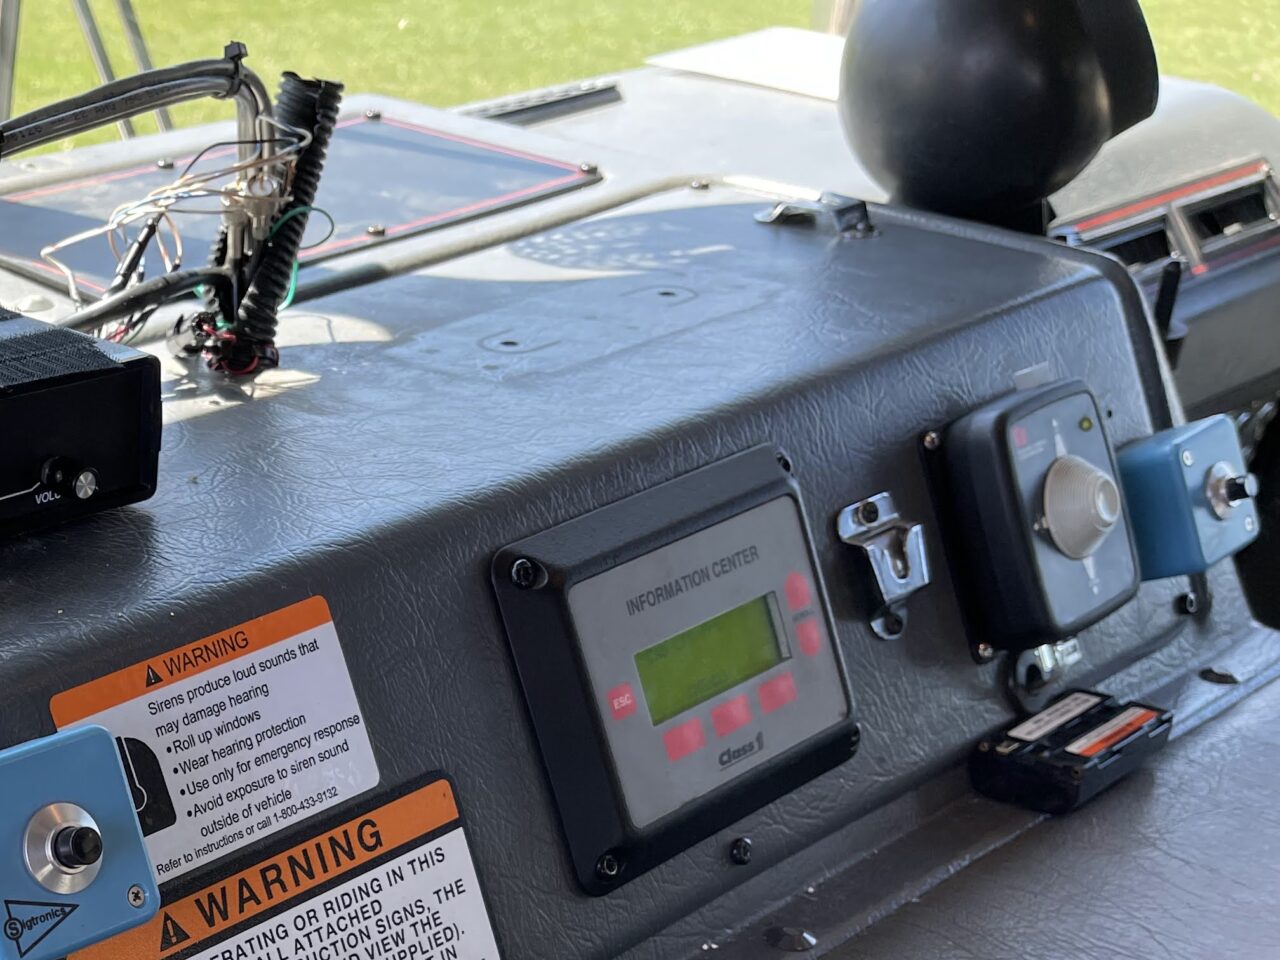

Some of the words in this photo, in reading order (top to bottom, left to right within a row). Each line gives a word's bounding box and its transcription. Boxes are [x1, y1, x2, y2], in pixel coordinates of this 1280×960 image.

[626, 568, 711, 616] INFORMATION
[712, 545, 760, 577] CENTER
[148, 694, 184, 715] Sirens
[186, 675, 231, 703] produce
[232, 662, 257, 682] loud
[258, 648, 297, 671] sounds
[298, 638, 319, 656] that
[163, 631, 248, 676] WARNING
[155, 719, 179, 737] may
[182, 701, 226, 726] damage
[227, 683, 269, 707] hearing
[613, 693, 632, 710] ESC
[172, 734, 195, 754] Roll
[197, 730, 212, 744] up
[214, 710, 261, 736] windows
[178, 754, 208, 774] Wear
[210, 737, 253, 761] hearing
[255, 715, 306, 746] protection
[186, 779, 209, 795] Use
[212, 767, 233, 785] only
[236, 760, 251, 774] for
[254, 735, 310, 766] emergency
[313, 714, 360, 741] response
[719, 737, 755, 766] Class
[753, 731, 764, 751] 1
[194, 793, 223, 817] Avoid
[226, 774, 275, 802] exposure
[276, 768, 287, 780] to
[290, 756, 316, 774] siren
[317, 738, 349, 762] sound
[156, 857, 181, 875] Refer
[183, 853, 193, 863] to
[193, 830, 244, 858] instructions
[245, 825, 254, 835] or
[256, 816, 272, 830] call
[273, 786, 338, 822] 1-800-433-9132
[200, 812, 239, 837] outside
[241, 803, 252, 818] of
[254, 789, 291, 812] vehicle
[194, 819, 382, 928] WARNING
[293, 908, 319, 931] OR
[322, 877, 382, 917] RIDING
[386, 866, 404, 886] IN
[407, 847, 444, 875] THIS
[6, 908, 67, 938] Sigtronics
[294, 899, 382, 955] ATTACHED
[375, 899, 430, 934] SIGNS,
[432, 878, 465, 904] THE
[364, 928, 404, 960] VIEW
[409, 910, 442, 937] THE
